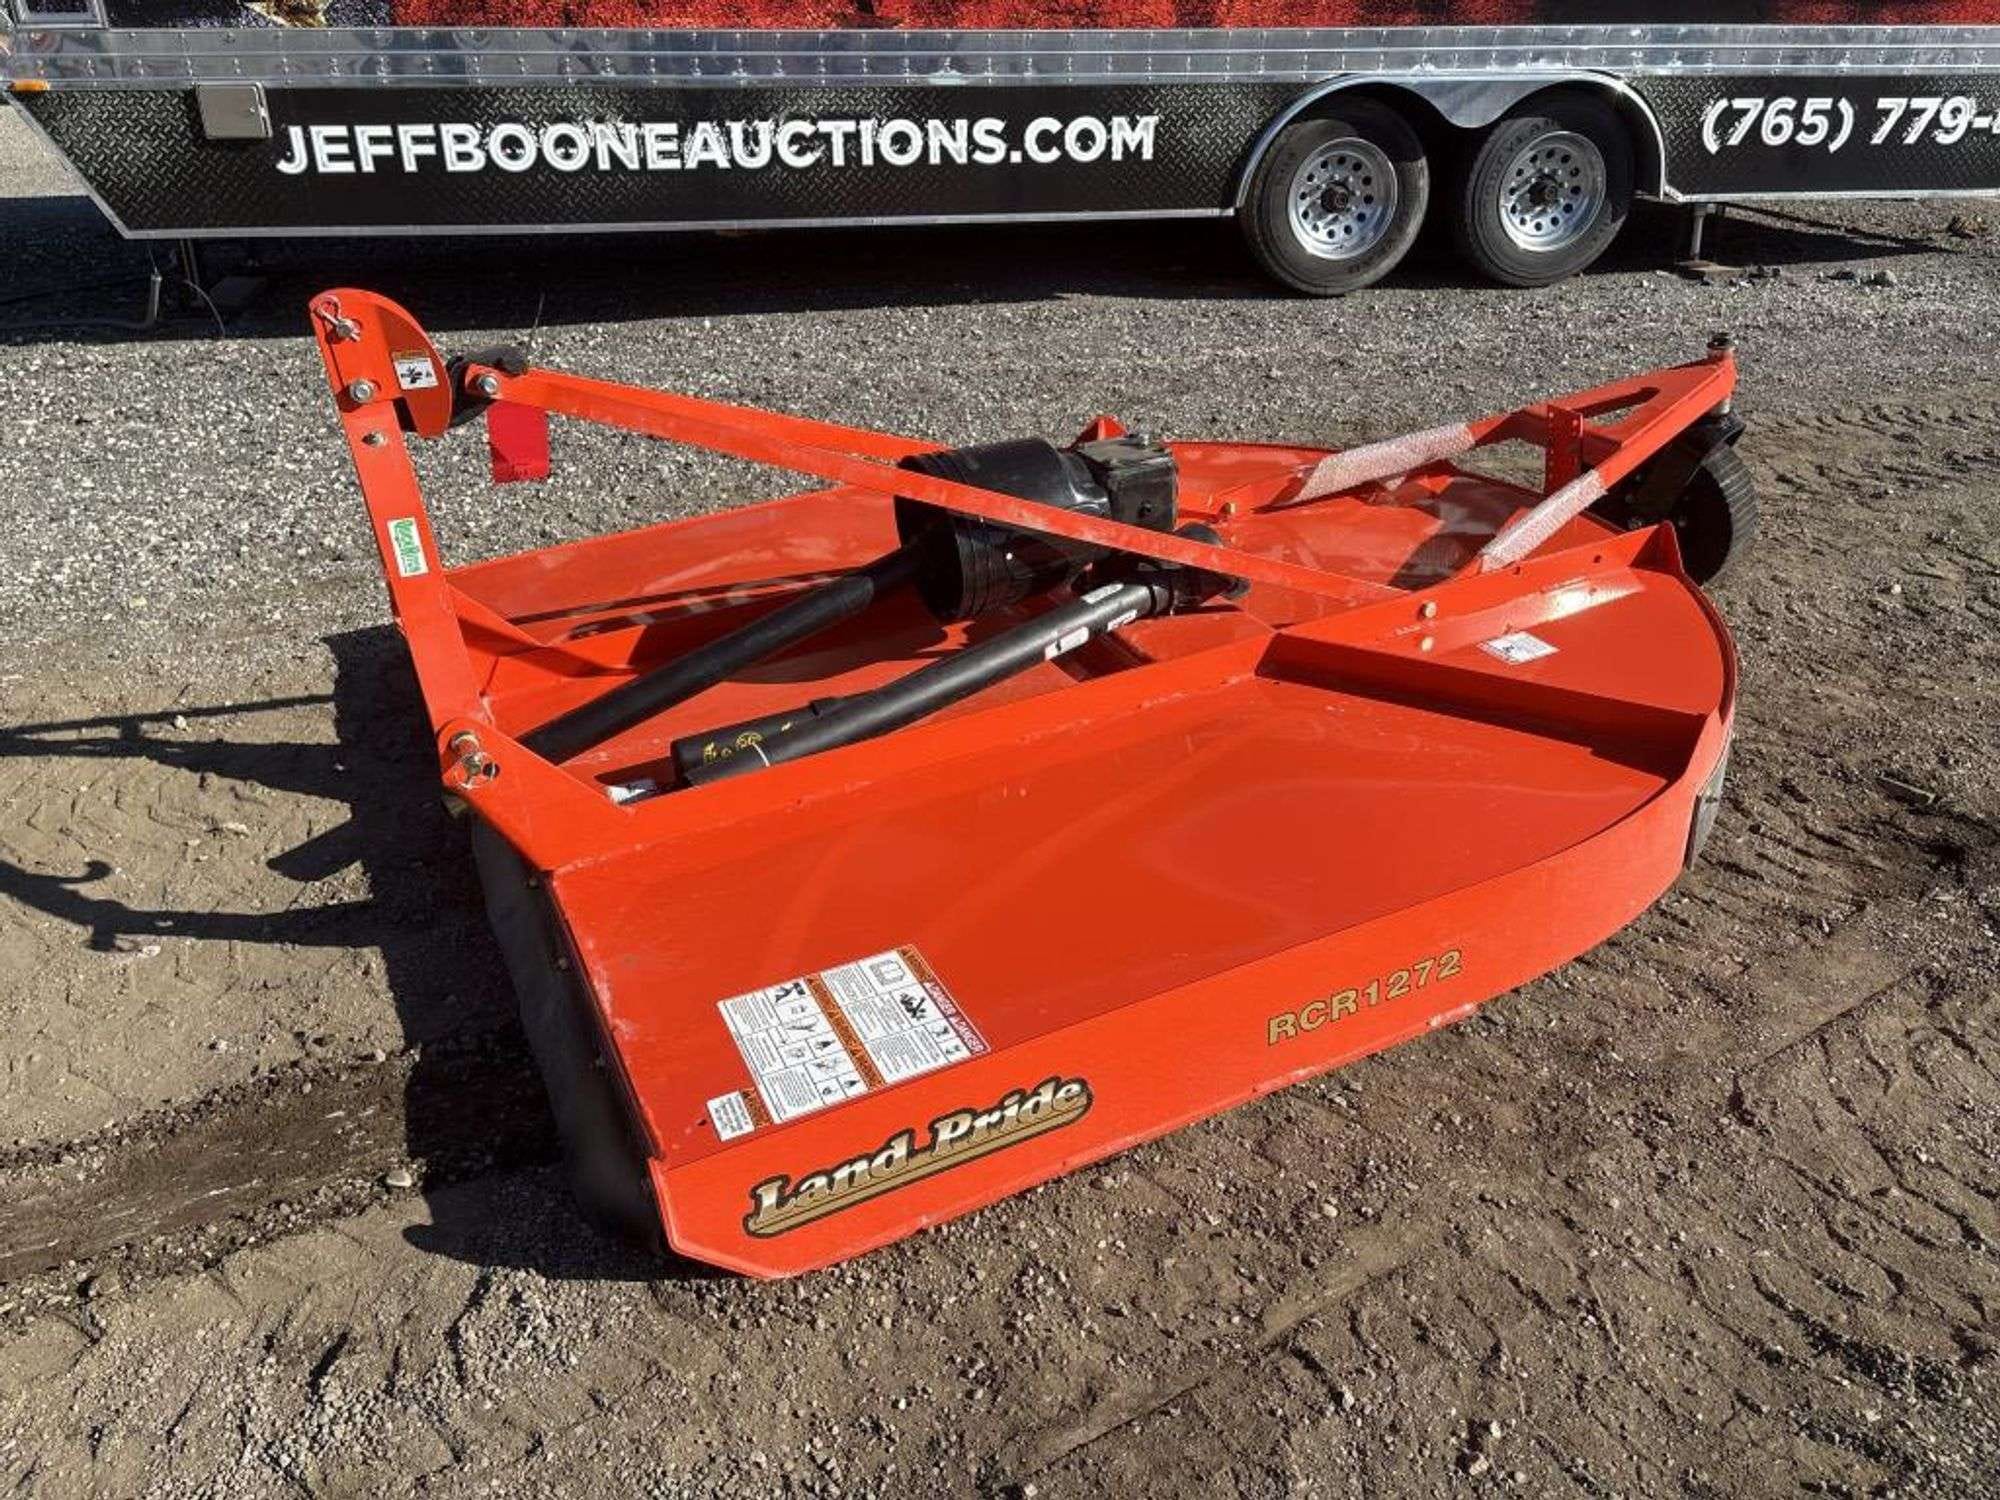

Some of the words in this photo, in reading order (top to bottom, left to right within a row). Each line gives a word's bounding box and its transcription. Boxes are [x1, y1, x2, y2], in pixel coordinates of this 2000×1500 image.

[275, 114, 1159, 175] JEFFBOONEAUCTIONS.COM
[1702, 97, 1854, 154] (765)
[1870, 96, 2000, 146] 779-
[1267, 950, 1463, 1046] RCR1272
[750, 1129, 915, 1223] Land
[930, 1078, 1089, 1157] Pride
